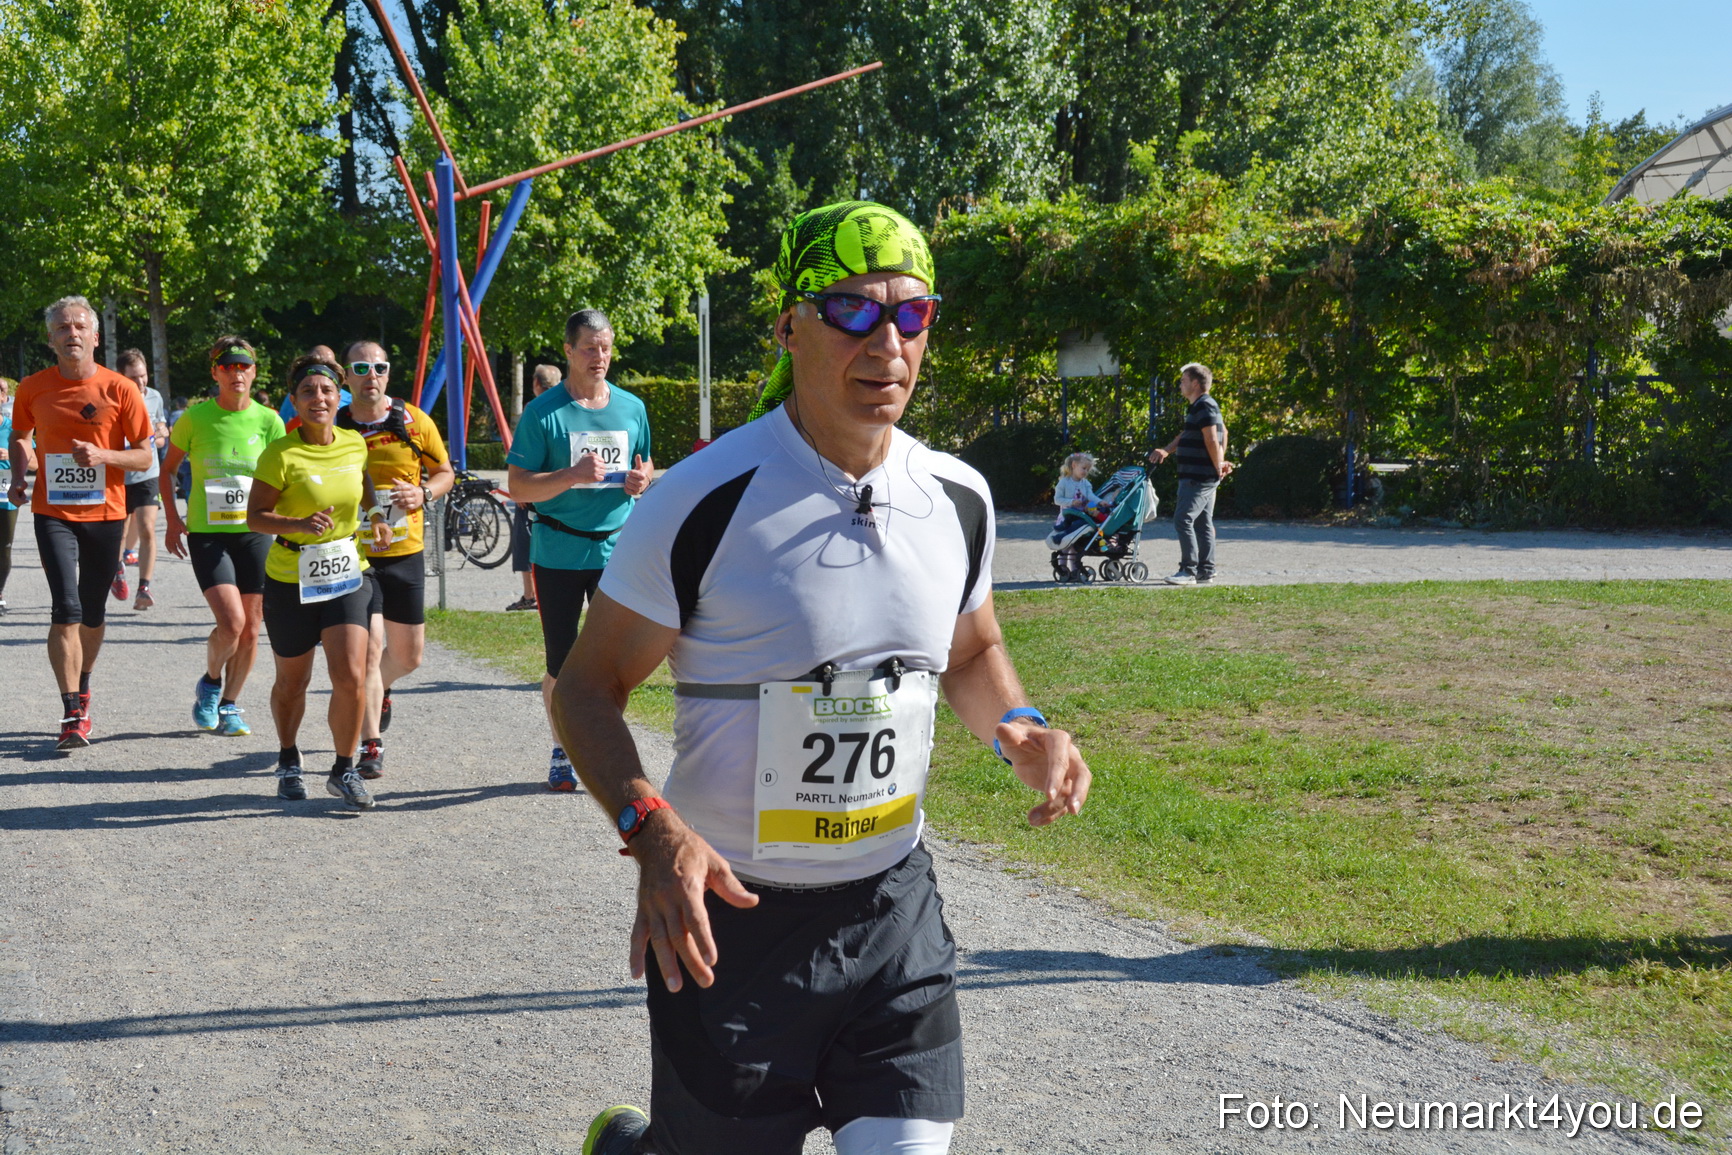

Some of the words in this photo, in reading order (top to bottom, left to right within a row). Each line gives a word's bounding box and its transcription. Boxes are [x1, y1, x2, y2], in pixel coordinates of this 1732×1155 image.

[54, 467, 97, 483] 2539
[62, 491, 90, 499] Michael
[225, 489, 245, 505] 66
[308, 555, 351, 578] 2552
[814, 694, 892, 716] BOCK
[814, 716, 838, 724] inspired
[801, 728, 896, 784] 276
[765, 773, 772, 783] D
[795, 792, 836, 804] PARTL
[838, 788, 885, 804] Neumarkt
[815, 815, 879, 839] Rainer
